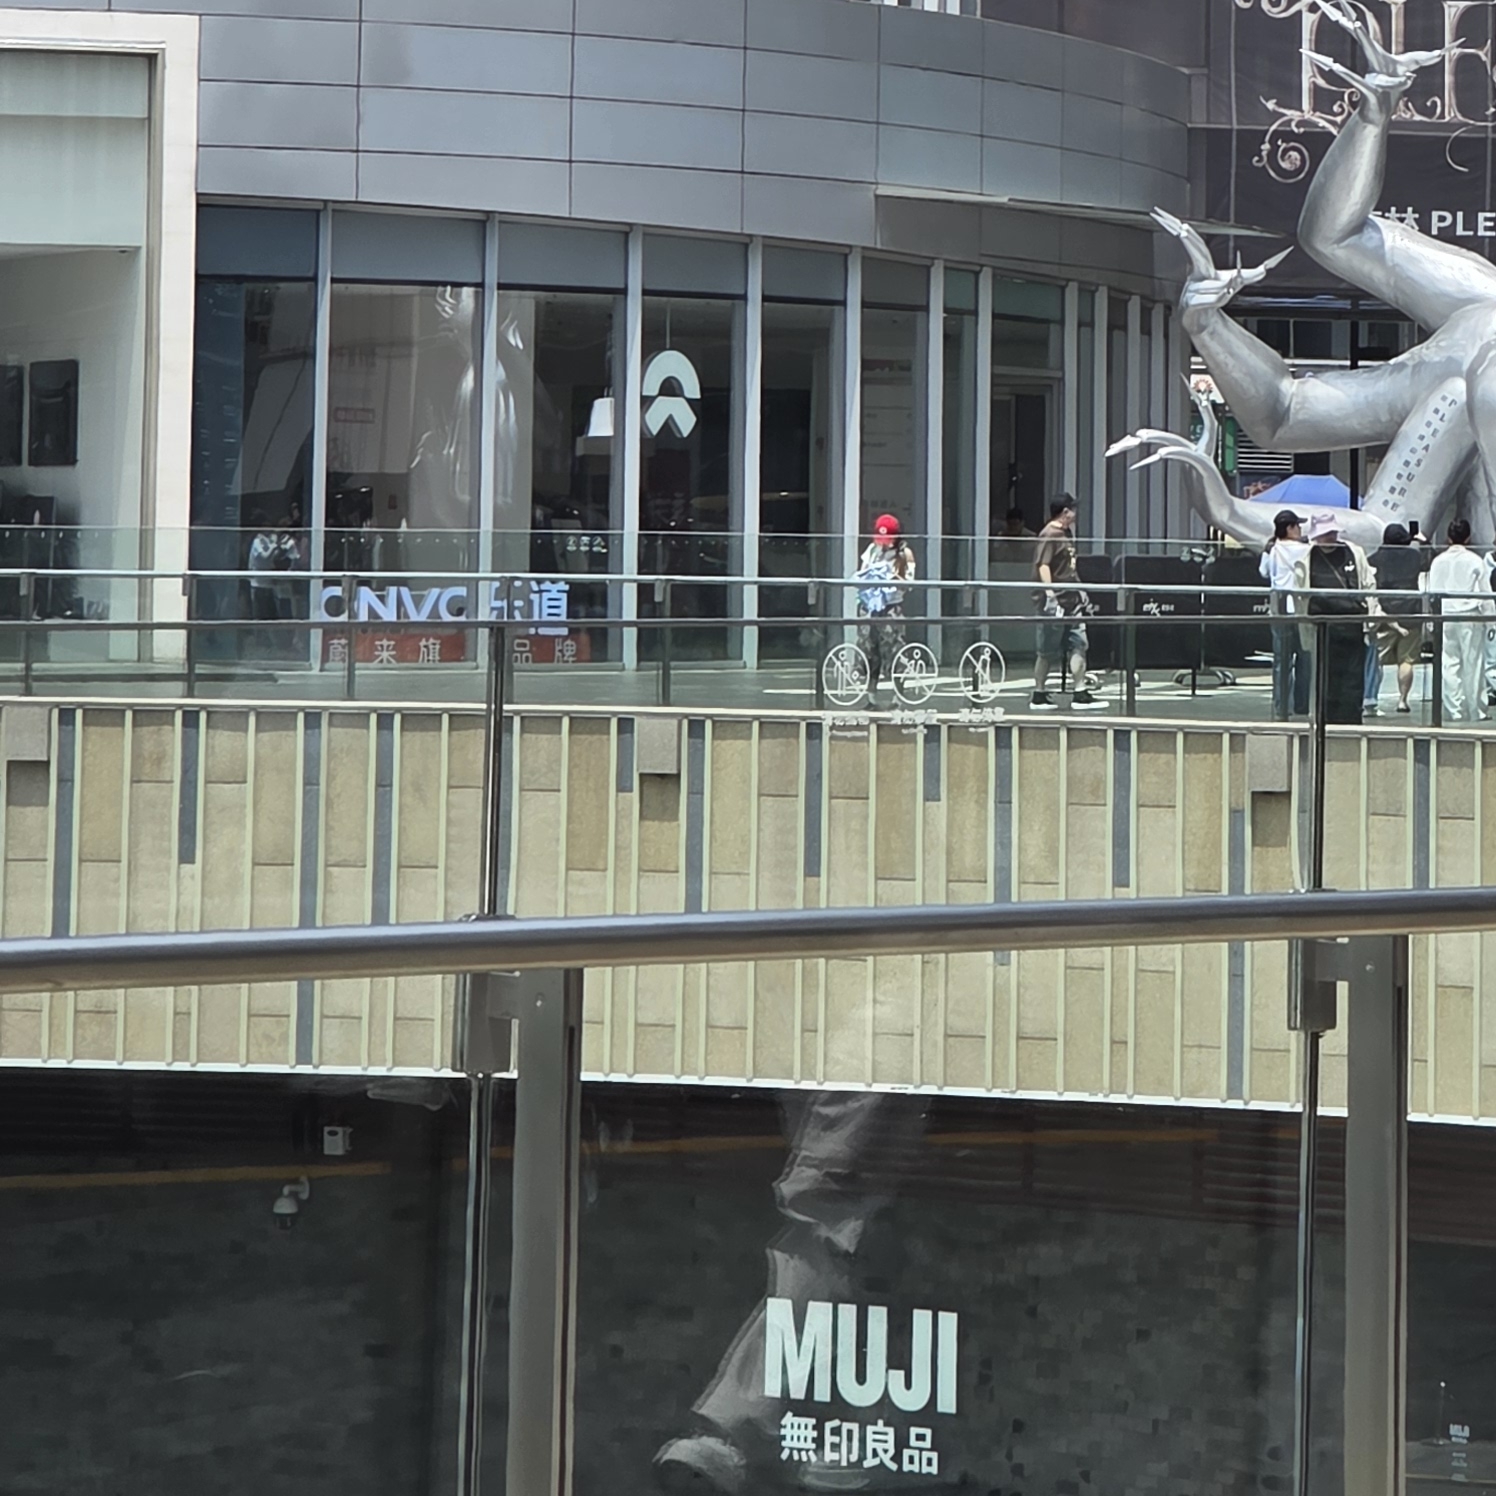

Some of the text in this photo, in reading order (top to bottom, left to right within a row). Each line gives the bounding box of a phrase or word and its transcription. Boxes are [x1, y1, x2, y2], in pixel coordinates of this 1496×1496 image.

[764, 1297, 958, 1414] MUJI
[779, 1410, 939, 1475] 無印良品
